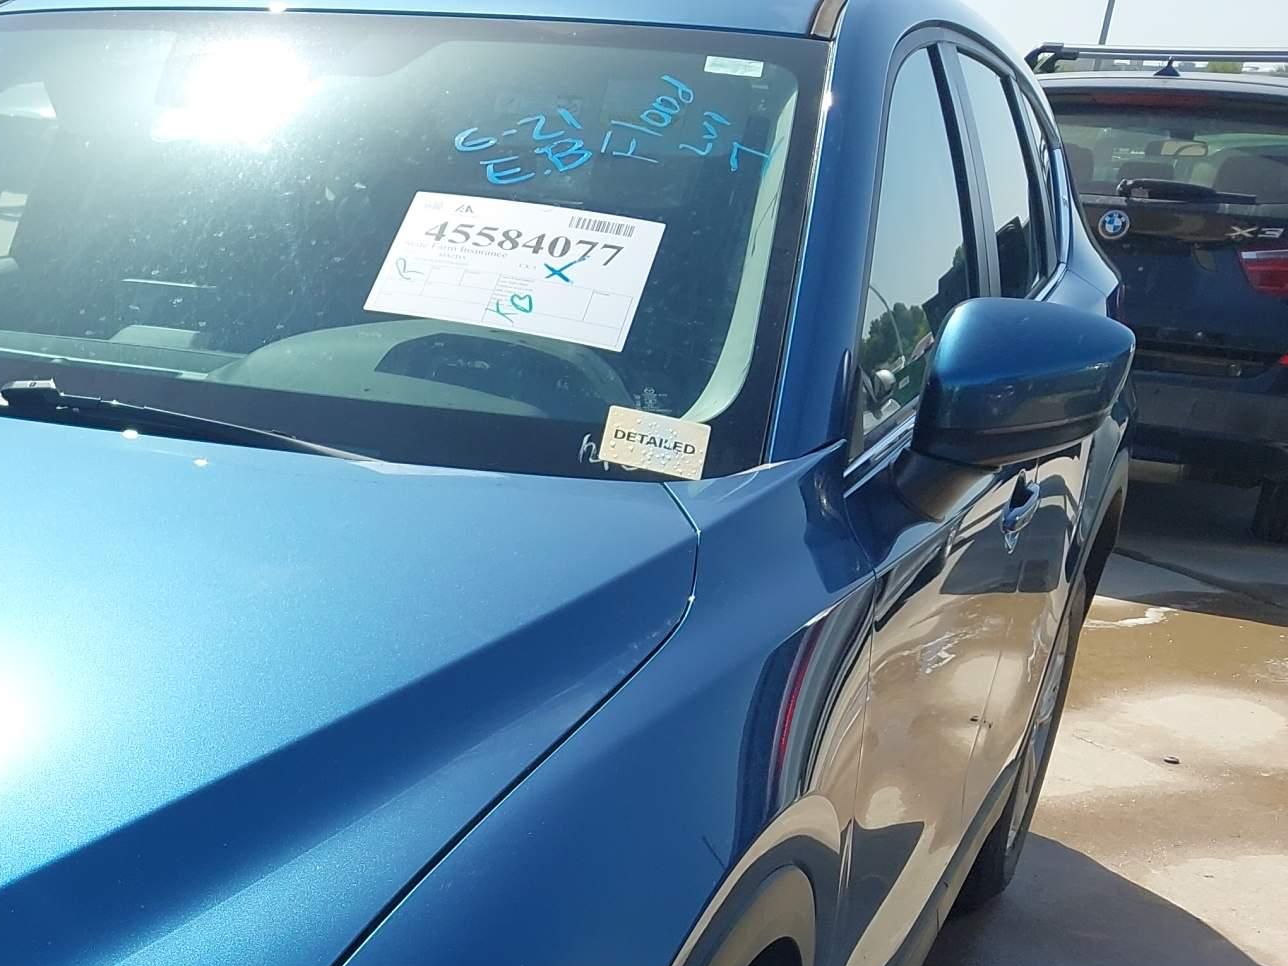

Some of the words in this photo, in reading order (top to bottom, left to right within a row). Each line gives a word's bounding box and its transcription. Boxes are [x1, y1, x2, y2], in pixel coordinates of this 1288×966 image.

[454, 106, 584, 152] 6-21
[424, 220, 625, 267] 45584077
[1224, 225, 1284, 239] X3
[613, 428, 696, 456] DETAILED
